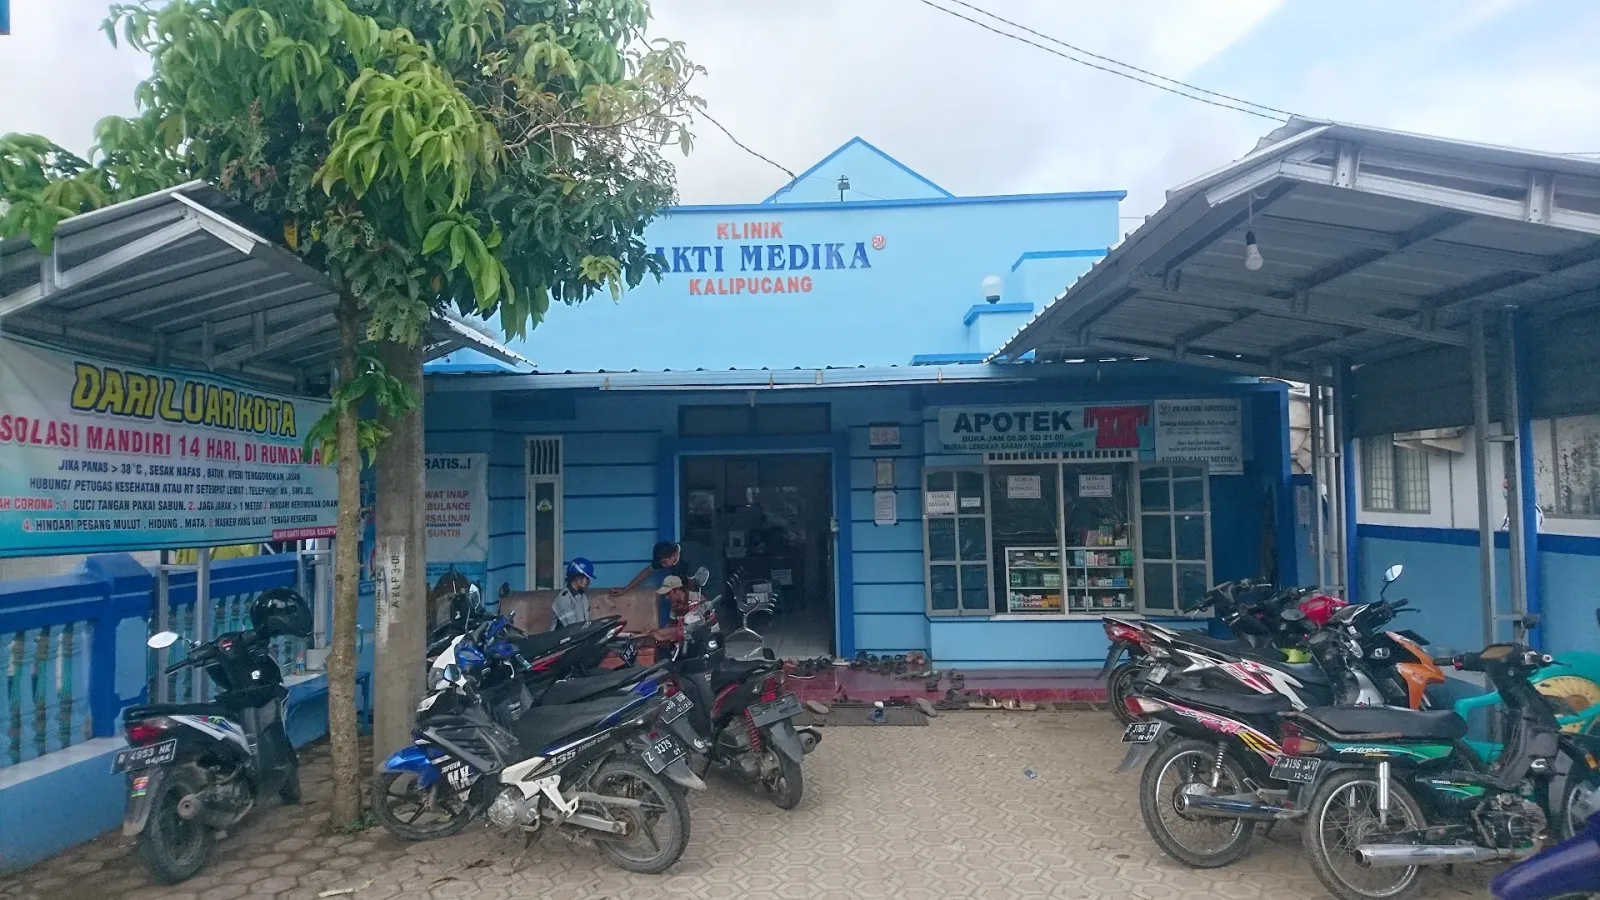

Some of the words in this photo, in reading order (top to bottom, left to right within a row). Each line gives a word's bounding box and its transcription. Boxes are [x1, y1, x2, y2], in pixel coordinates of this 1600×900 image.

[717, 222, 783, 240] KLINIK
[650, 245, 723, 274] AKTI
[740, 242, 872, 272] MEDIKA
[689, 277, 813, 296] KALIPUCANG
[71, 361, 160, 420] DARI
[159, 377, 237, 430] LUAR
[237, 392, 297, 438] KOTA
[953, 410, 1073, 433] APOTEK
[86, 425, 171, 457] MANDIRI
[178, 436, 200, 457] 14
[245, 443, 257, 462] DI
[962, 435, 986, 443] BUKA
[988, 435, 1004, 443] JAM
[59, 460, 79, 471] JIKA
[82, 461, 109, 473] PANAS
[150, 465, 174, 477] SESAK
[176, 467, 201, 478] NAFAS
[30, 478, 70, 491] HUBUNGI
[74, 479, 112, 492] PETUGAS
[115, 481, 160, 494] KESEHATAN
[162, 483, 182, 494] ATAU
[184, 484, 193, 494] RT
[425, 490, 444, 500] WAT
[447, 491, 469, 500] INAP
[14, 499, 53, 510] CORONA
[73, 500, 95, 511] CUCI
[98, 500, 130, 511] TANGAN
[132, 500, 155, 511] PAKAI
[322, 499, 338, 508] ORAN
[426, 502, 471, 511] BULANCE
[36, 520, 74, 531] HINDARI
[77, 519, 110, 531] PEGANG
[114, 519, 140, 530] MULUT
[149, 518, 177, 529] HIDUNG
[425, 513, 470, 523] RSALINAN
[427, 529, 461, 538] SUNTIK
[644, 751, 655, 762] Z
[655, 739, 673, 755] 3379
